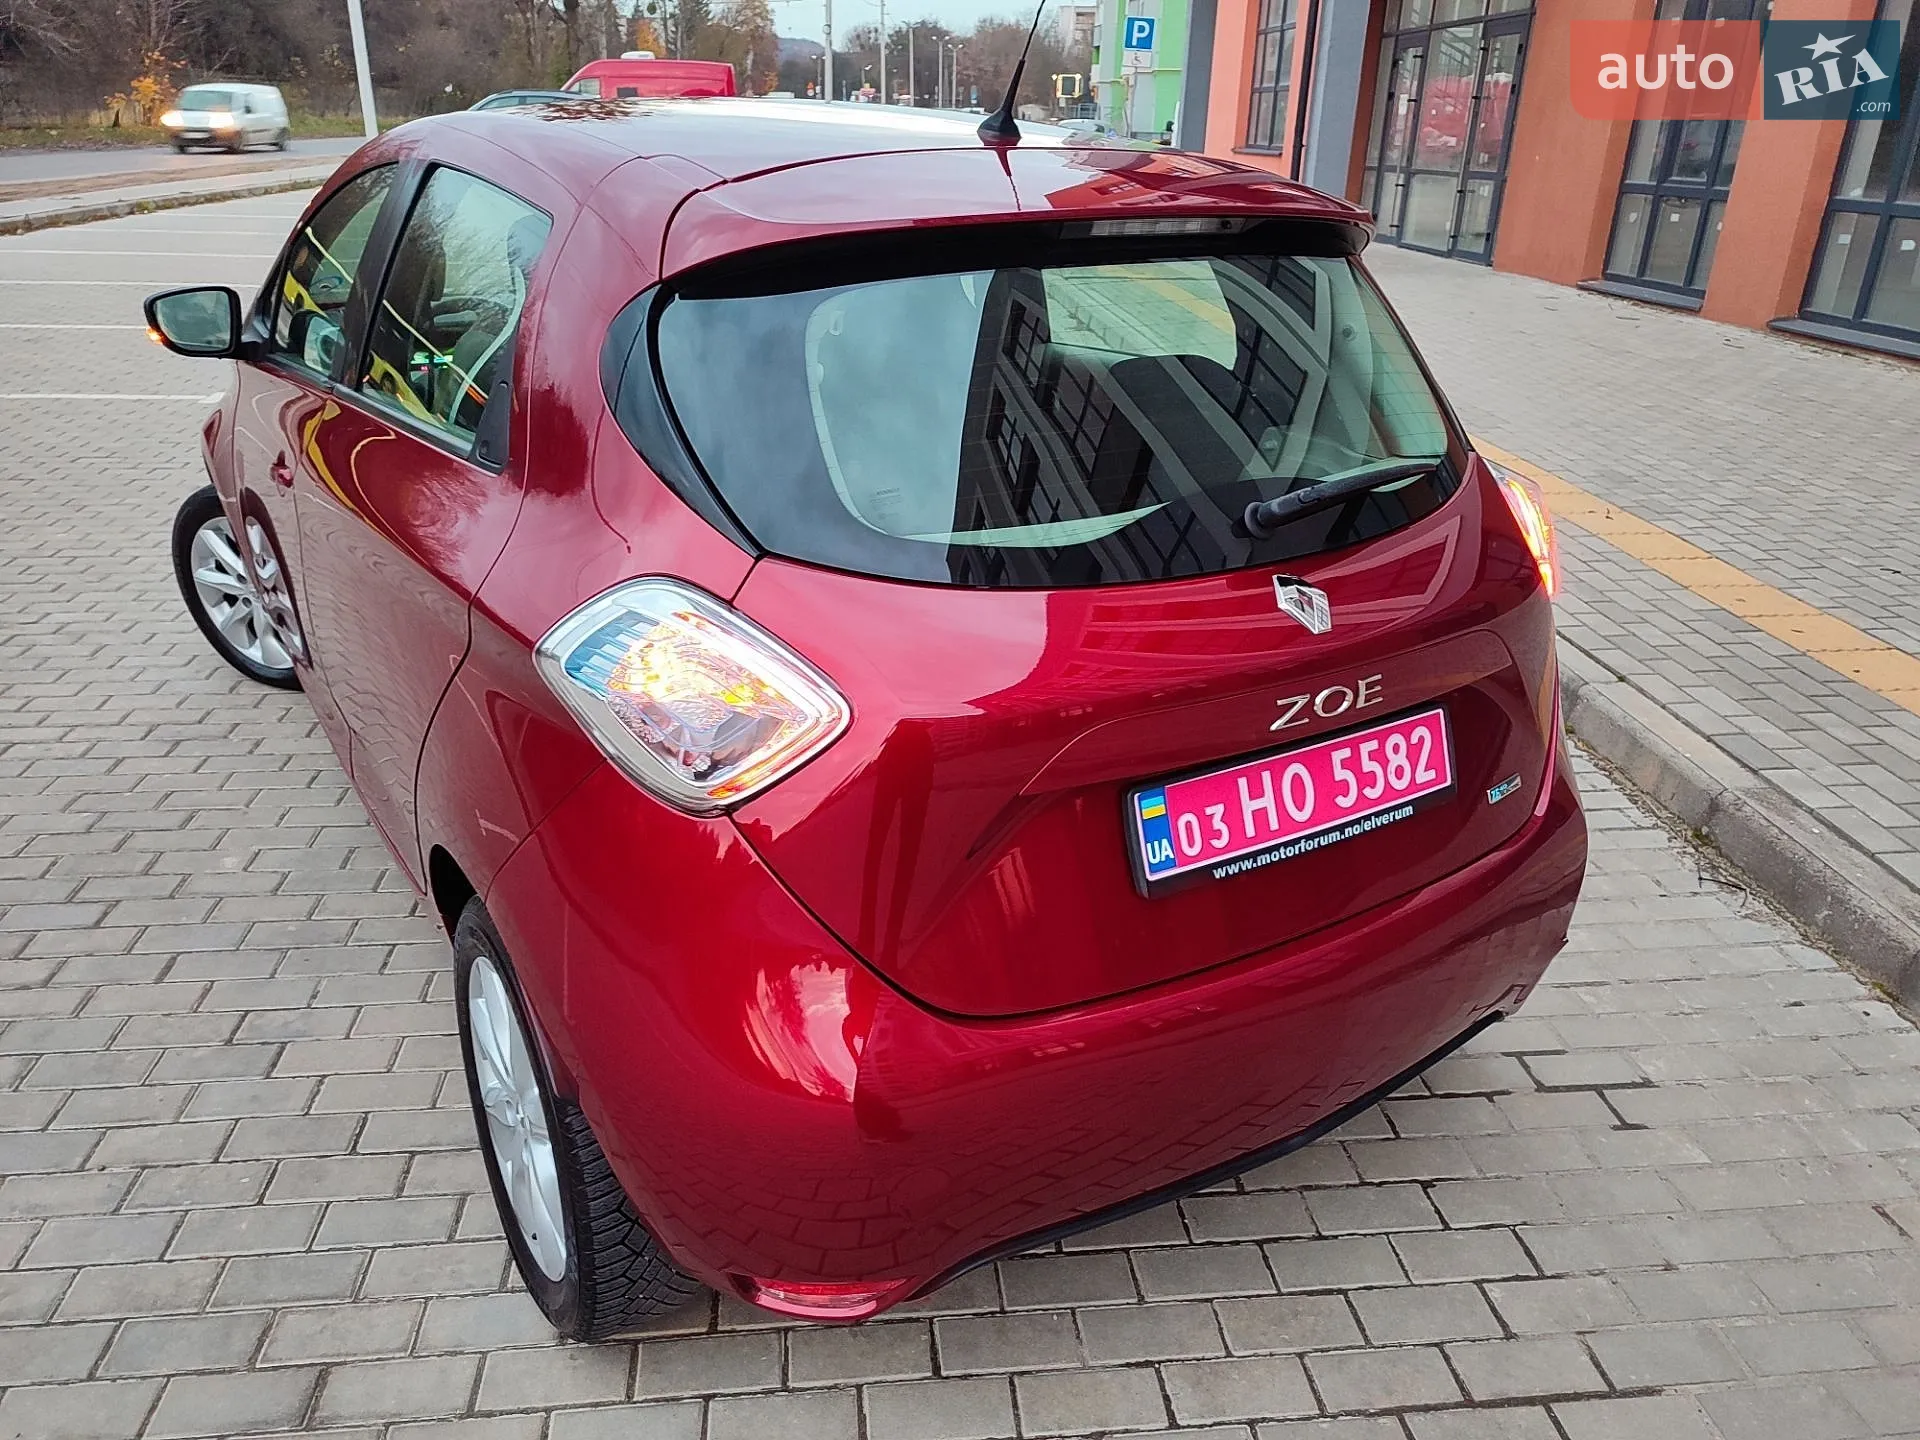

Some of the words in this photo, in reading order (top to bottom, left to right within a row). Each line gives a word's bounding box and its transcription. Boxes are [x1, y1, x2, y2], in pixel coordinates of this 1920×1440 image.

[1131, 20, 1150, 46] P
[1269, 674, 1384, 732] ZOE
[1177, 802, 1231, 858] 03
[1238, 762, 1315, 840] HO
[1331, 725, 1438, 809] 5582
[1146, 838, 1175, 865] UA
[1212, 803, 1414, 880] www.motorforum.no/elverum
